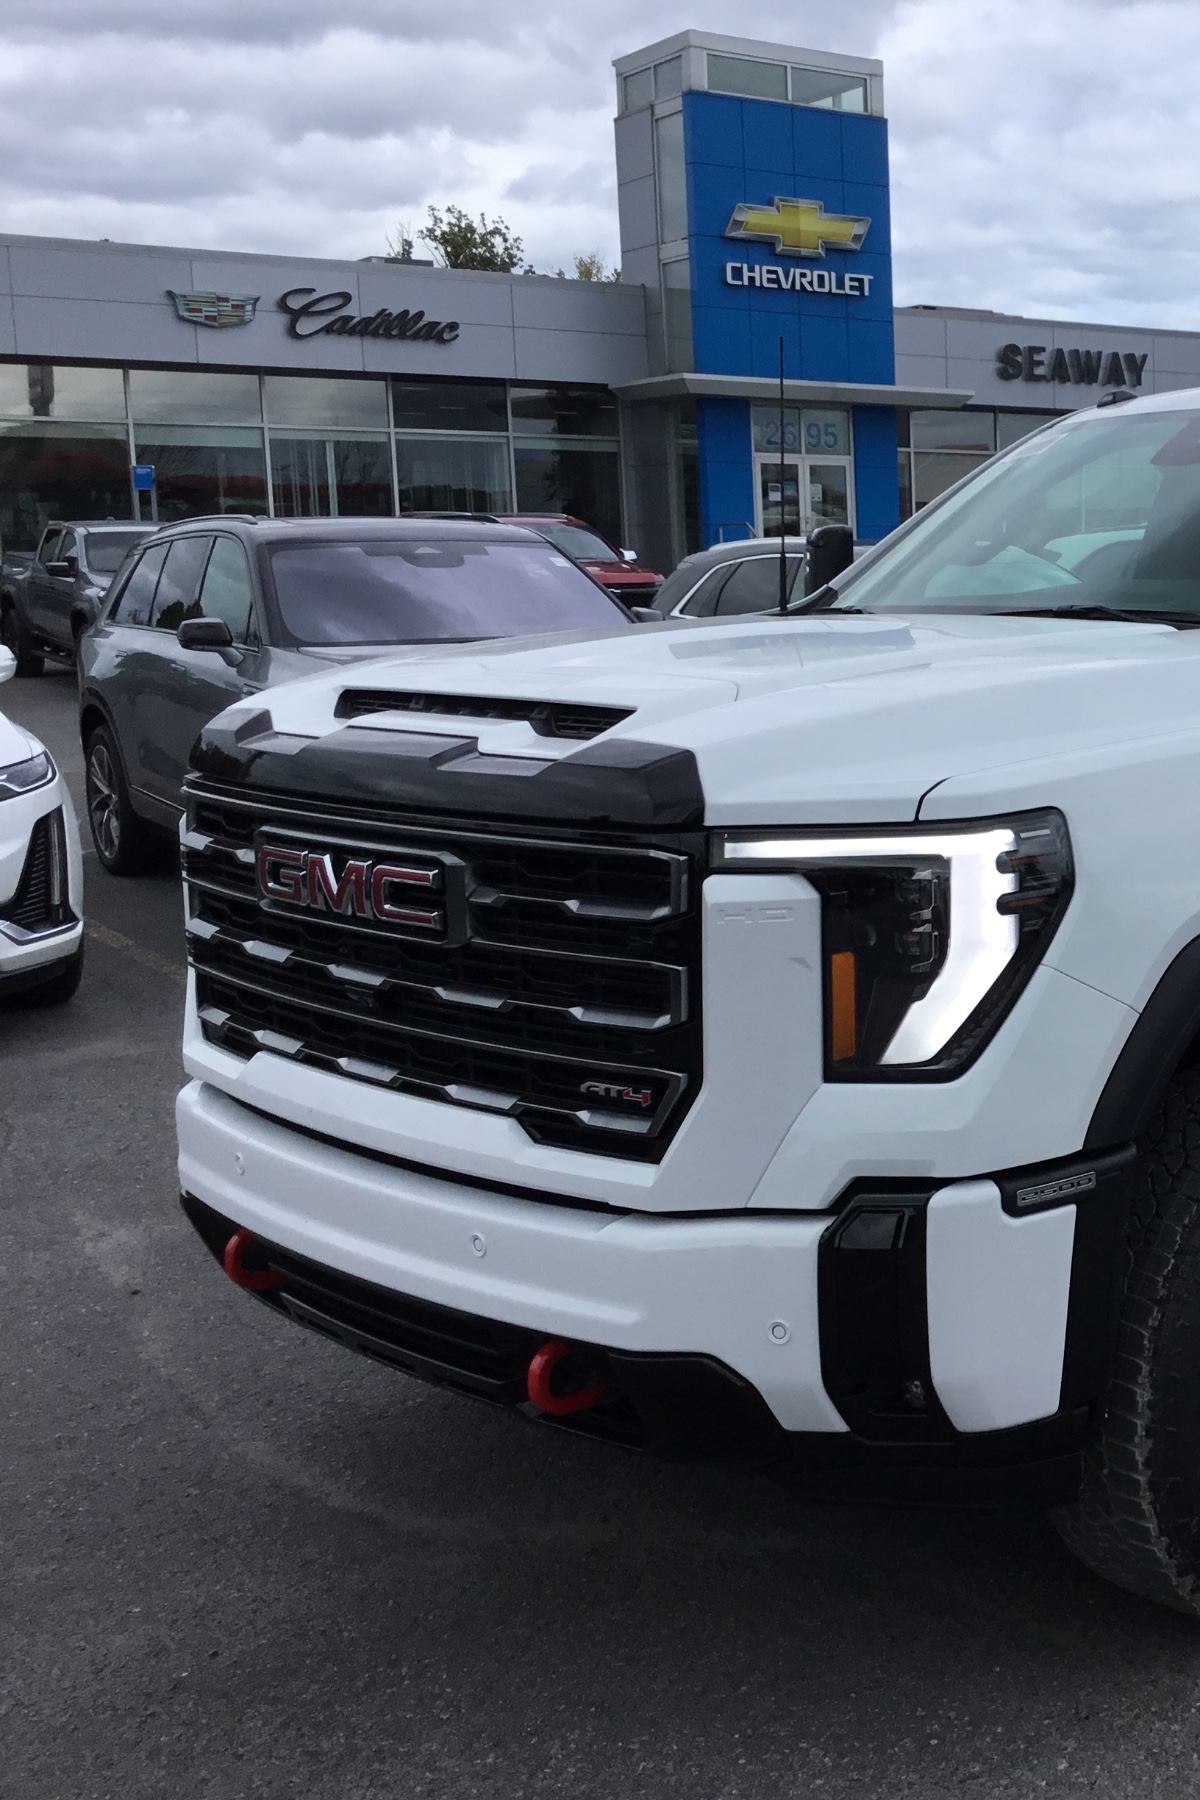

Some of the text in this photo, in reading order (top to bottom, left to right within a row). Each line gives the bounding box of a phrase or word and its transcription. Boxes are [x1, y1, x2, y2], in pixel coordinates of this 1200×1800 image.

[726, 261, 874, 296] CHEVROLET
[279, 287, 460, 343] Cadillac
[996, 343, 1149, 387] SEAWAY
[764, 420, 839, 449] 2695
[258, 846, 444, 930] GMC
[580, 1081, 652, 1108] AT4
[1021, 1177, 1093, 1203] 2500
